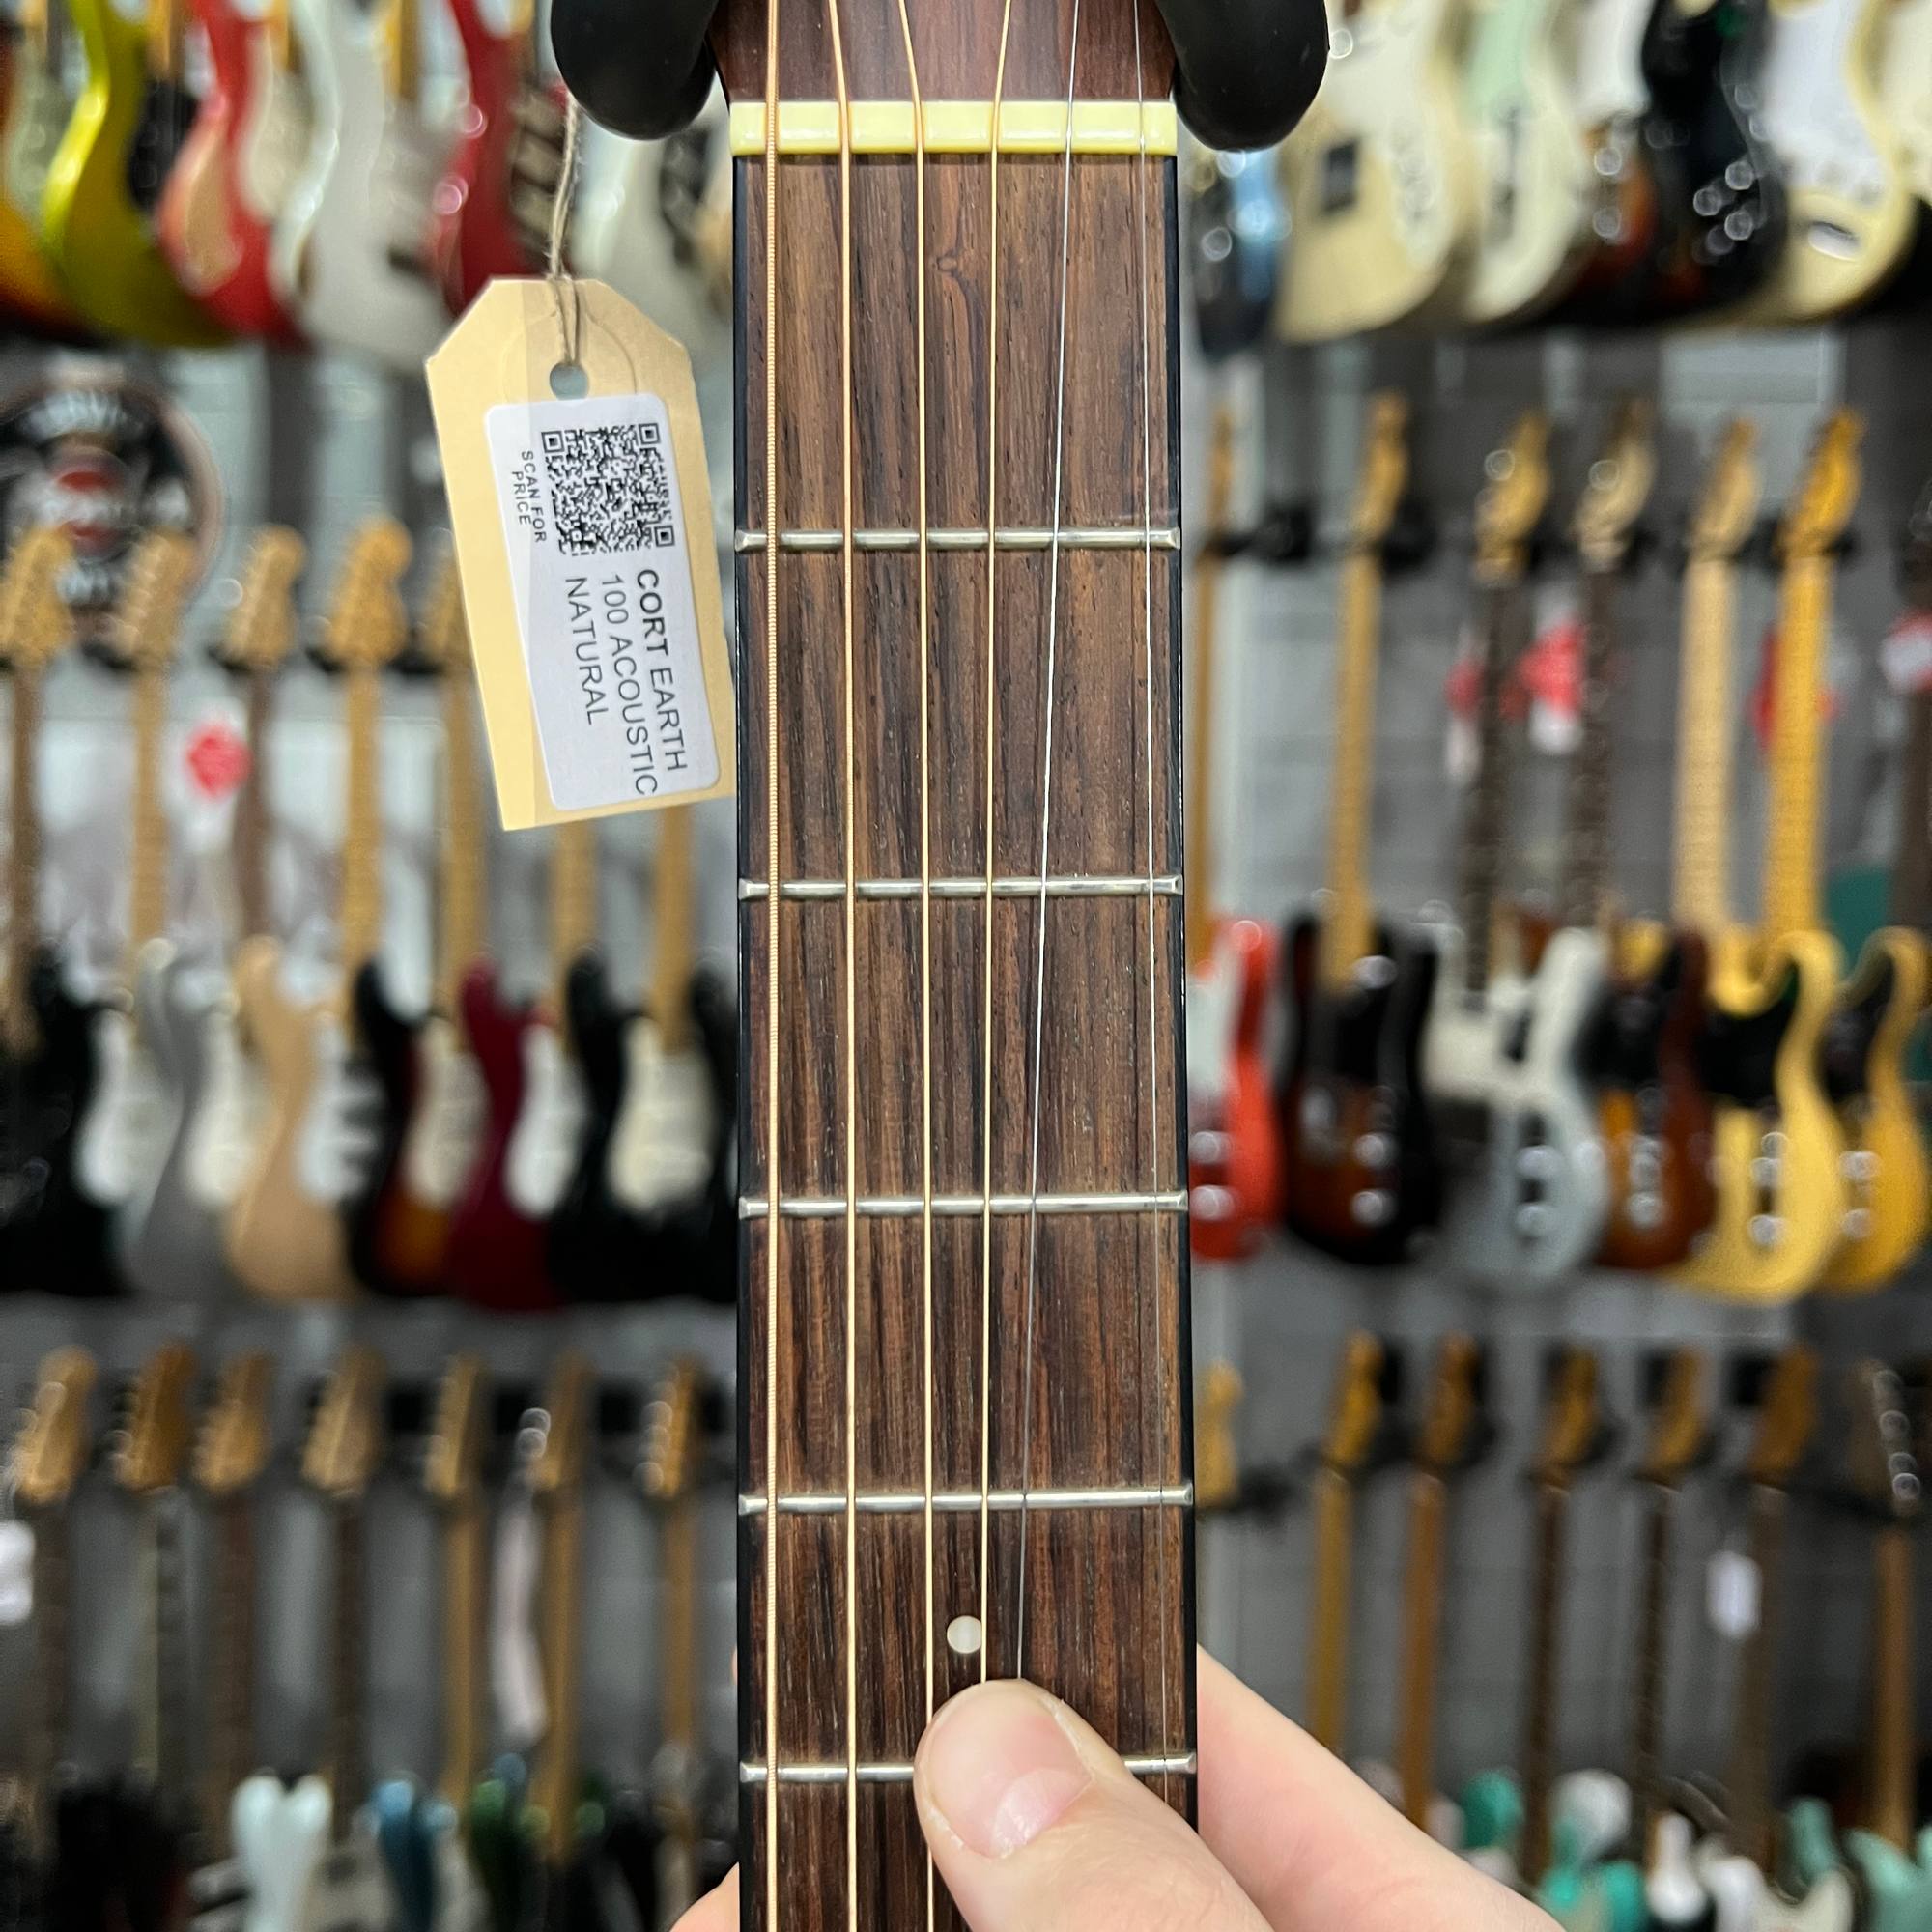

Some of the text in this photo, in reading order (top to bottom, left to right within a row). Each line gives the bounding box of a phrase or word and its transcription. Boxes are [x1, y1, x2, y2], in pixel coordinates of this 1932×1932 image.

[511, 471, 531, 526] PRICE
[522, 450, 547, 543] SCAN FOR
[565, 577, 609, 725] NATURAL
[602, 574, 658, 795] 100 ACOUSTIC
[637, 569, 688, 771] CORT EARTH
